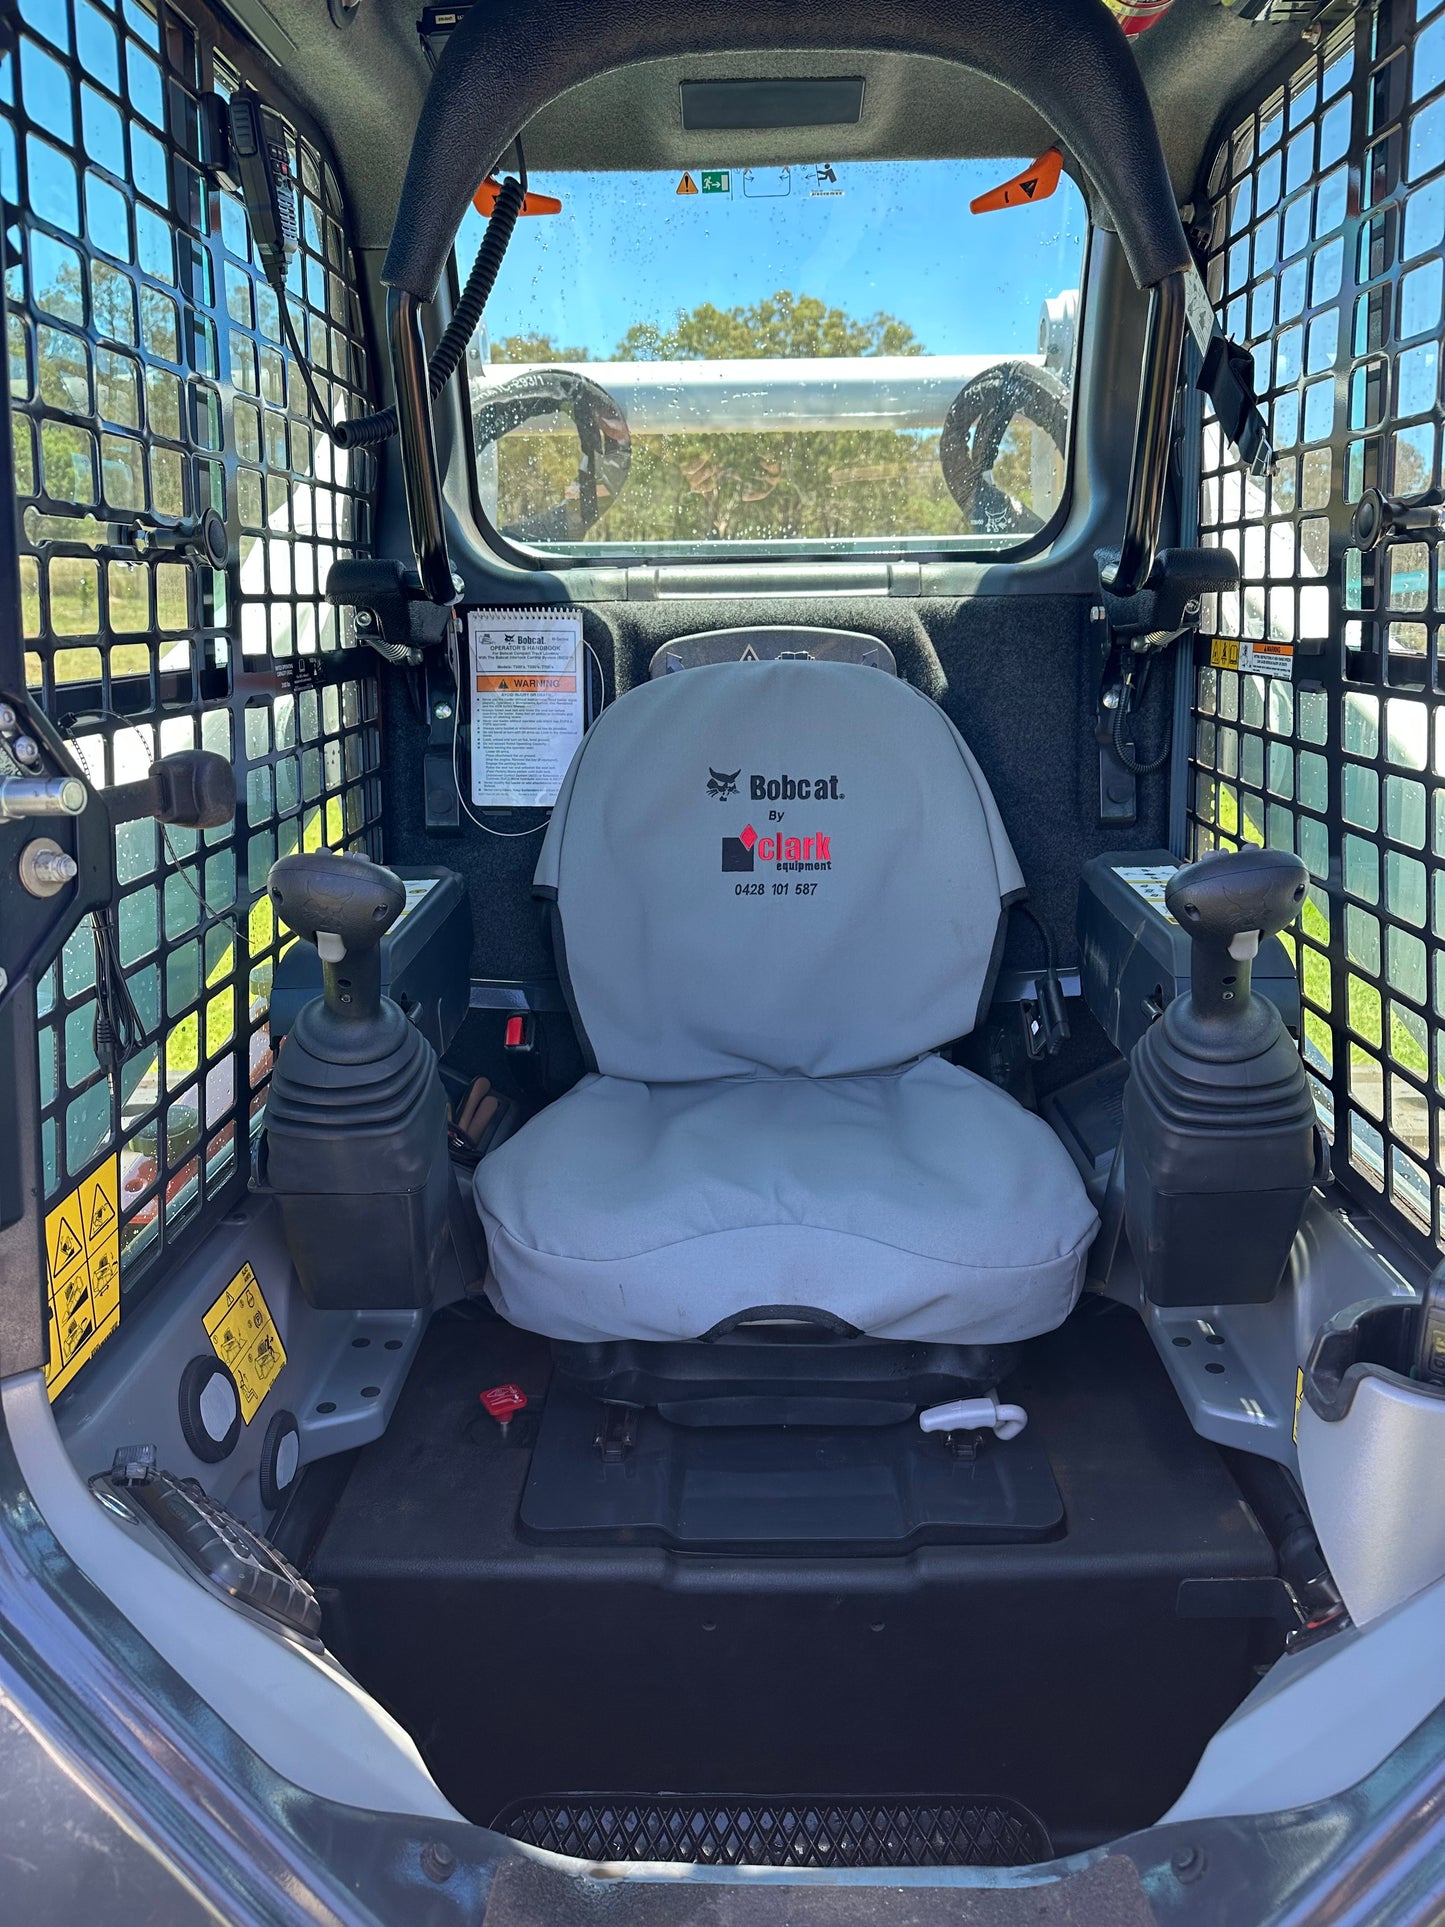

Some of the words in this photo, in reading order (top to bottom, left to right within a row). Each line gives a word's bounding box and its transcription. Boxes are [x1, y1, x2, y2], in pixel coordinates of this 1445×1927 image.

[517, 635, 545, 645] Bobcat
[513, 679, 560, 688] WARNING
[750, 774, 839, 801] Bobcat
[768, 810, 785, 823] By
[757, 831, 832, 861] clark
[776, 860, 832, 873] equipment
[734, 883, 766, 896] 0428
[771, 883, 789, 896] 101
[794, 883, 818, 896] 587
